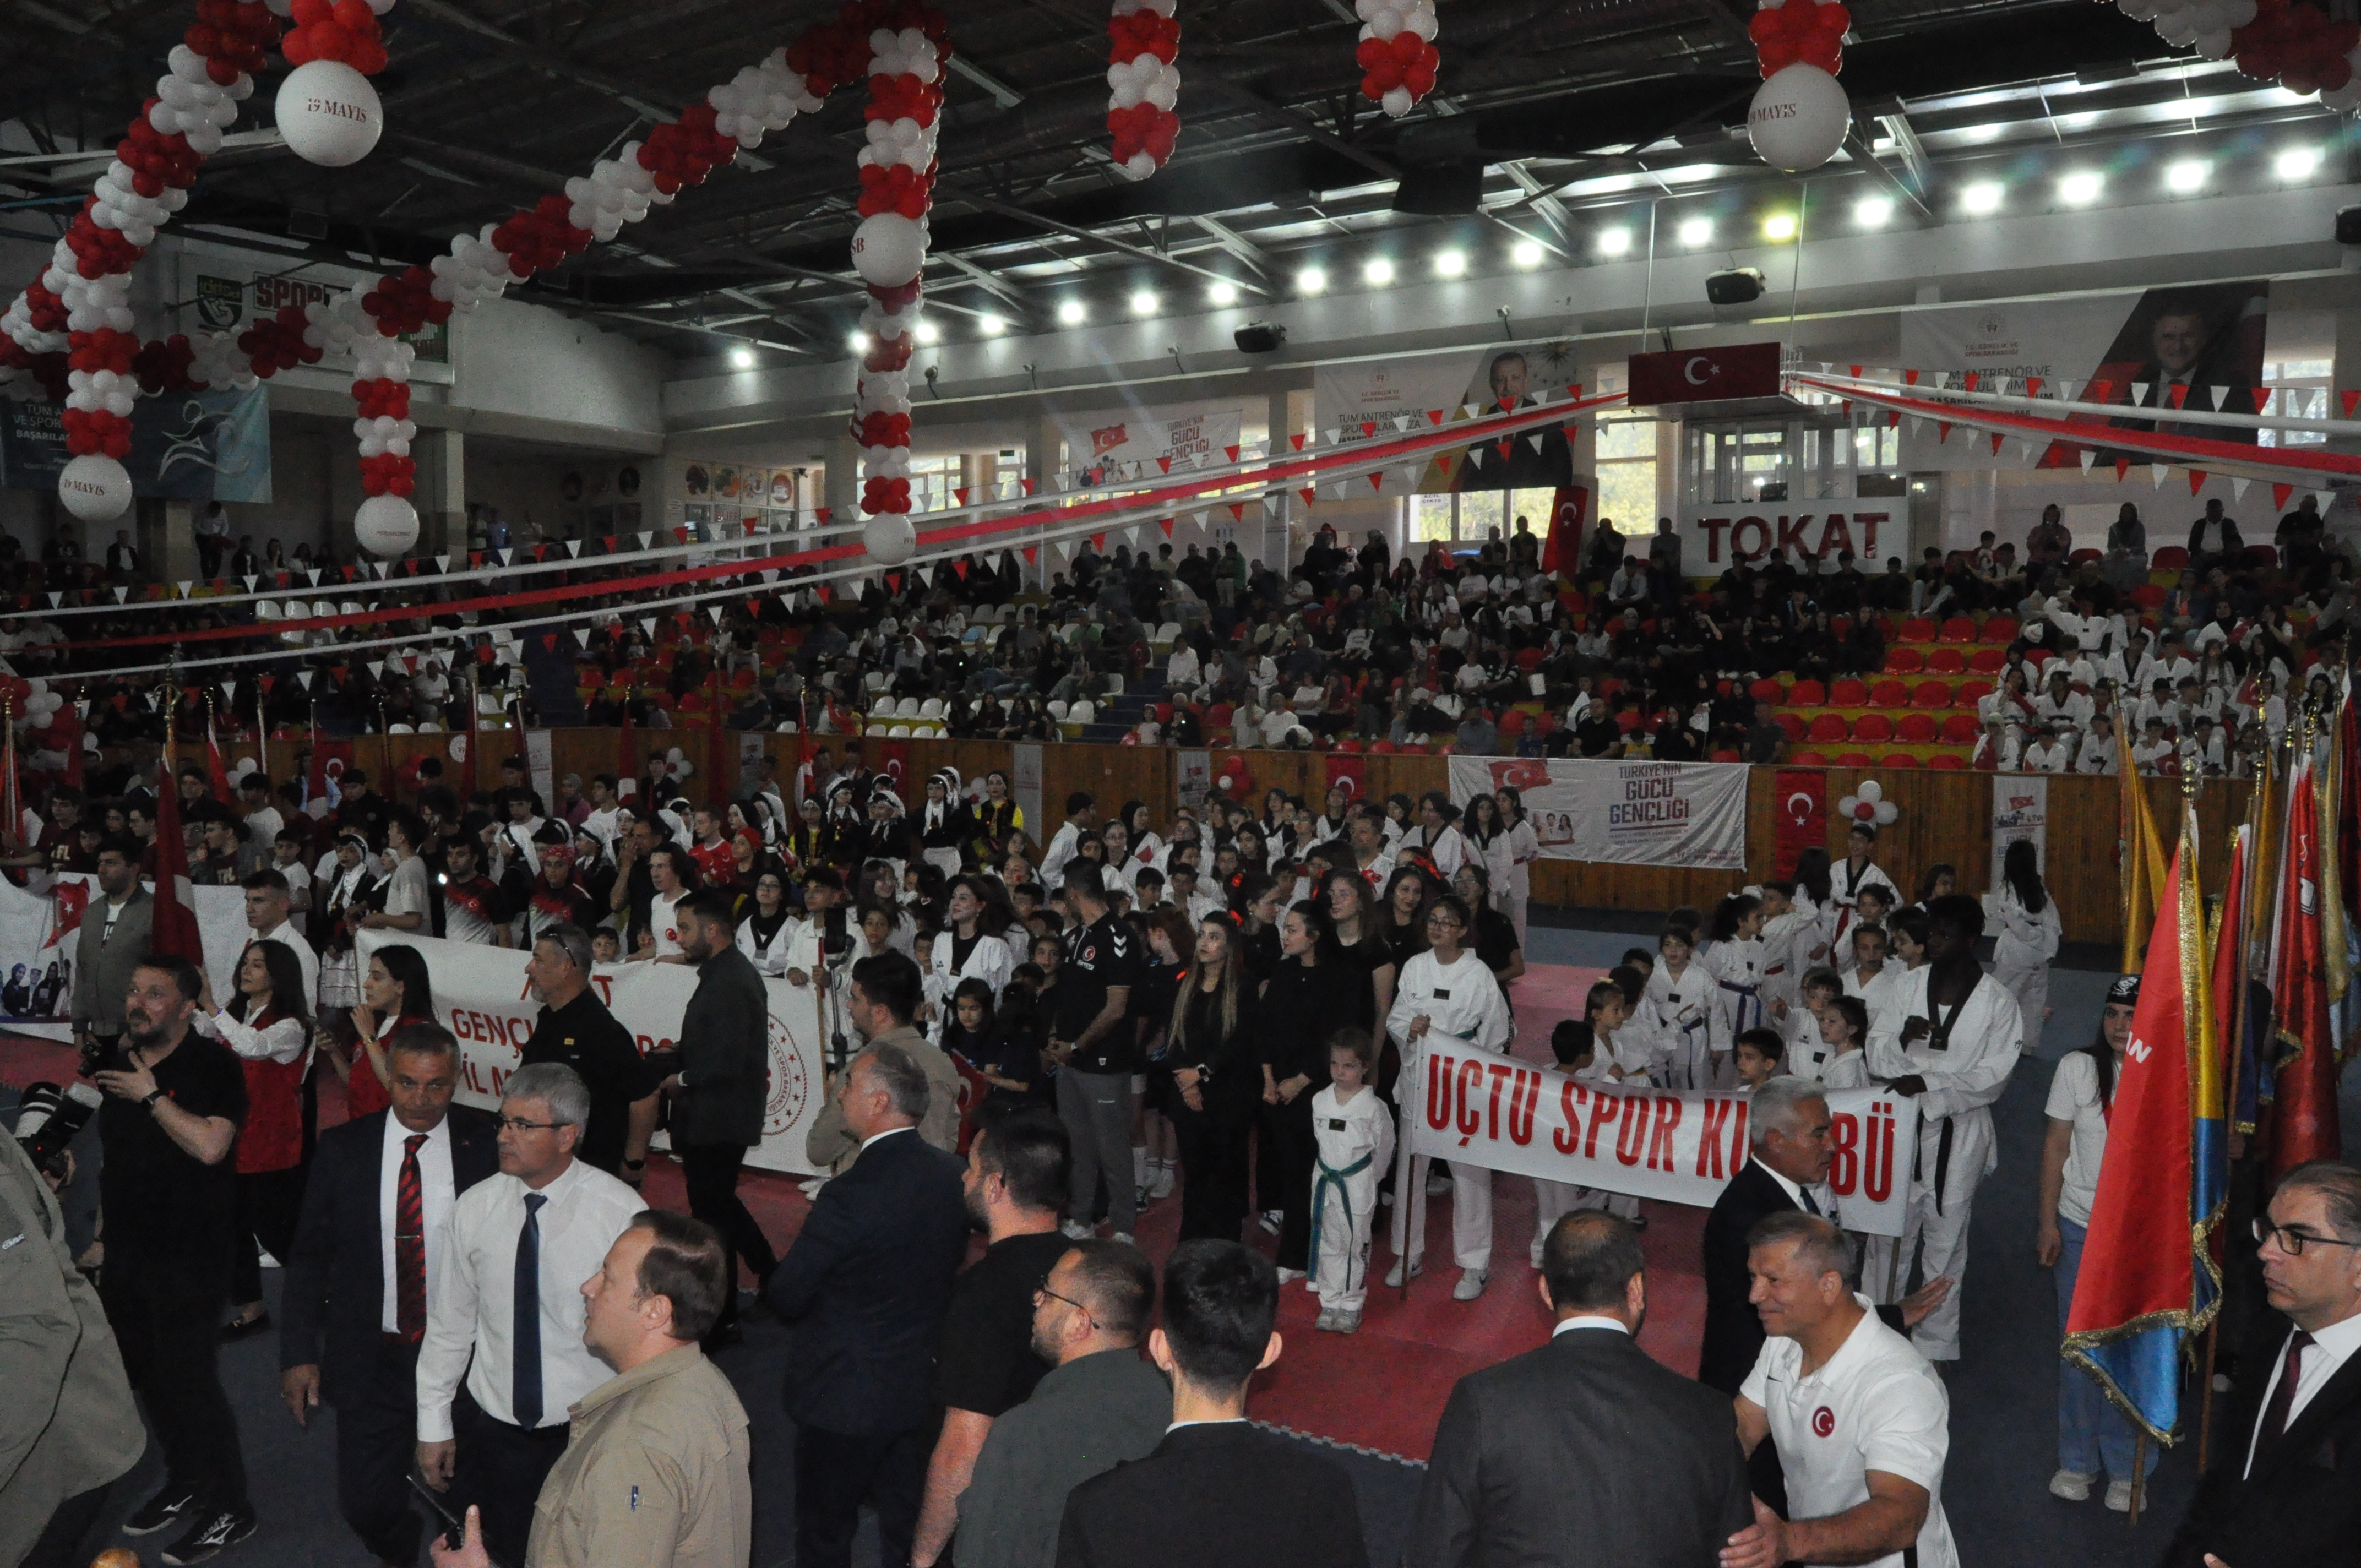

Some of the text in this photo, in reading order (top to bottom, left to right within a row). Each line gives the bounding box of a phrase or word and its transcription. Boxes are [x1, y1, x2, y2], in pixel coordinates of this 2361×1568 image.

[308, 99, 366, 122] 19 MAYIS
[1758, 103, 1796, 121] MAYIS
[2036, 366, 2051, 376] VE
[1412, 409, 1424, 418] VE
[74, 481, 105, 496] MAYIS
[1698, 512, 1889, 562] TOKAT
[1626, 777, 1673, 801] GÜCÜ
[1609, 797, 1689, 824] GENÇLİĞİ
[463, 1053, 488, 1095] İL
[1428, 1054, 1541, 1146] UÇTU
[1552, 1081, 1682, 1173] SPOR
